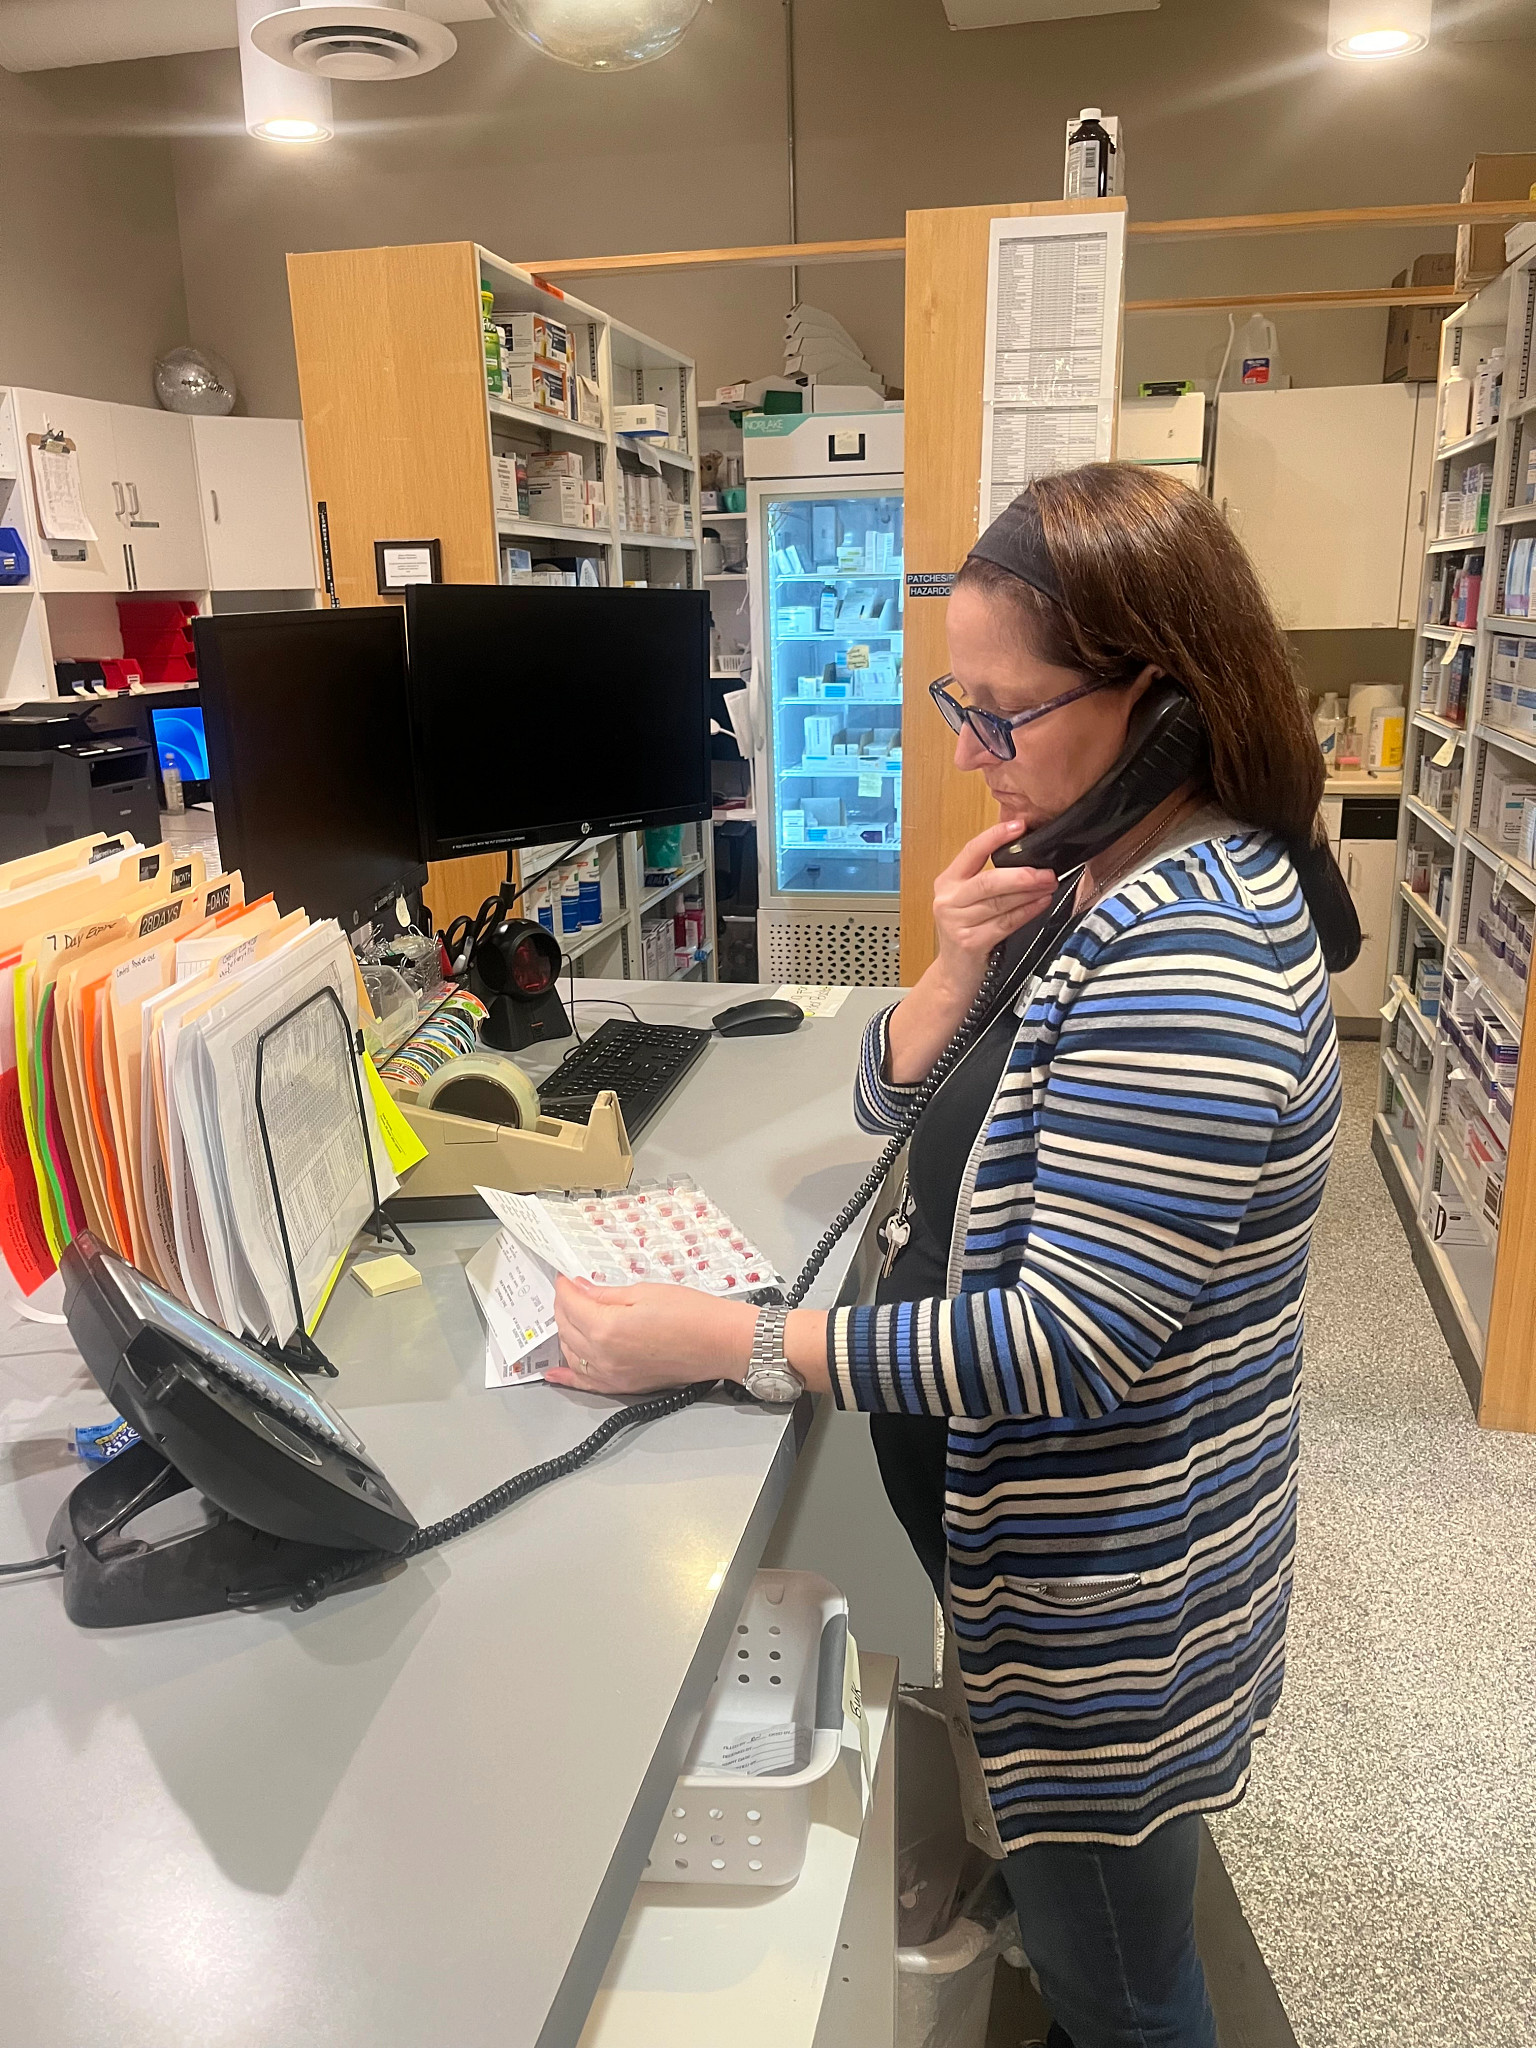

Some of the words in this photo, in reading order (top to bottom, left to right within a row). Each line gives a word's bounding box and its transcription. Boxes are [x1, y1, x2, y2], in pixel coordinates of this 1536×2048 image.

[745, 420, 783, 430] NORLAKE
[141, 905, 180, 936] 28DAYS
[46, 934, 58, 951] 7
[64, 932, 84, 950] Day
[849, 1680, 862, 1719] Bulk
